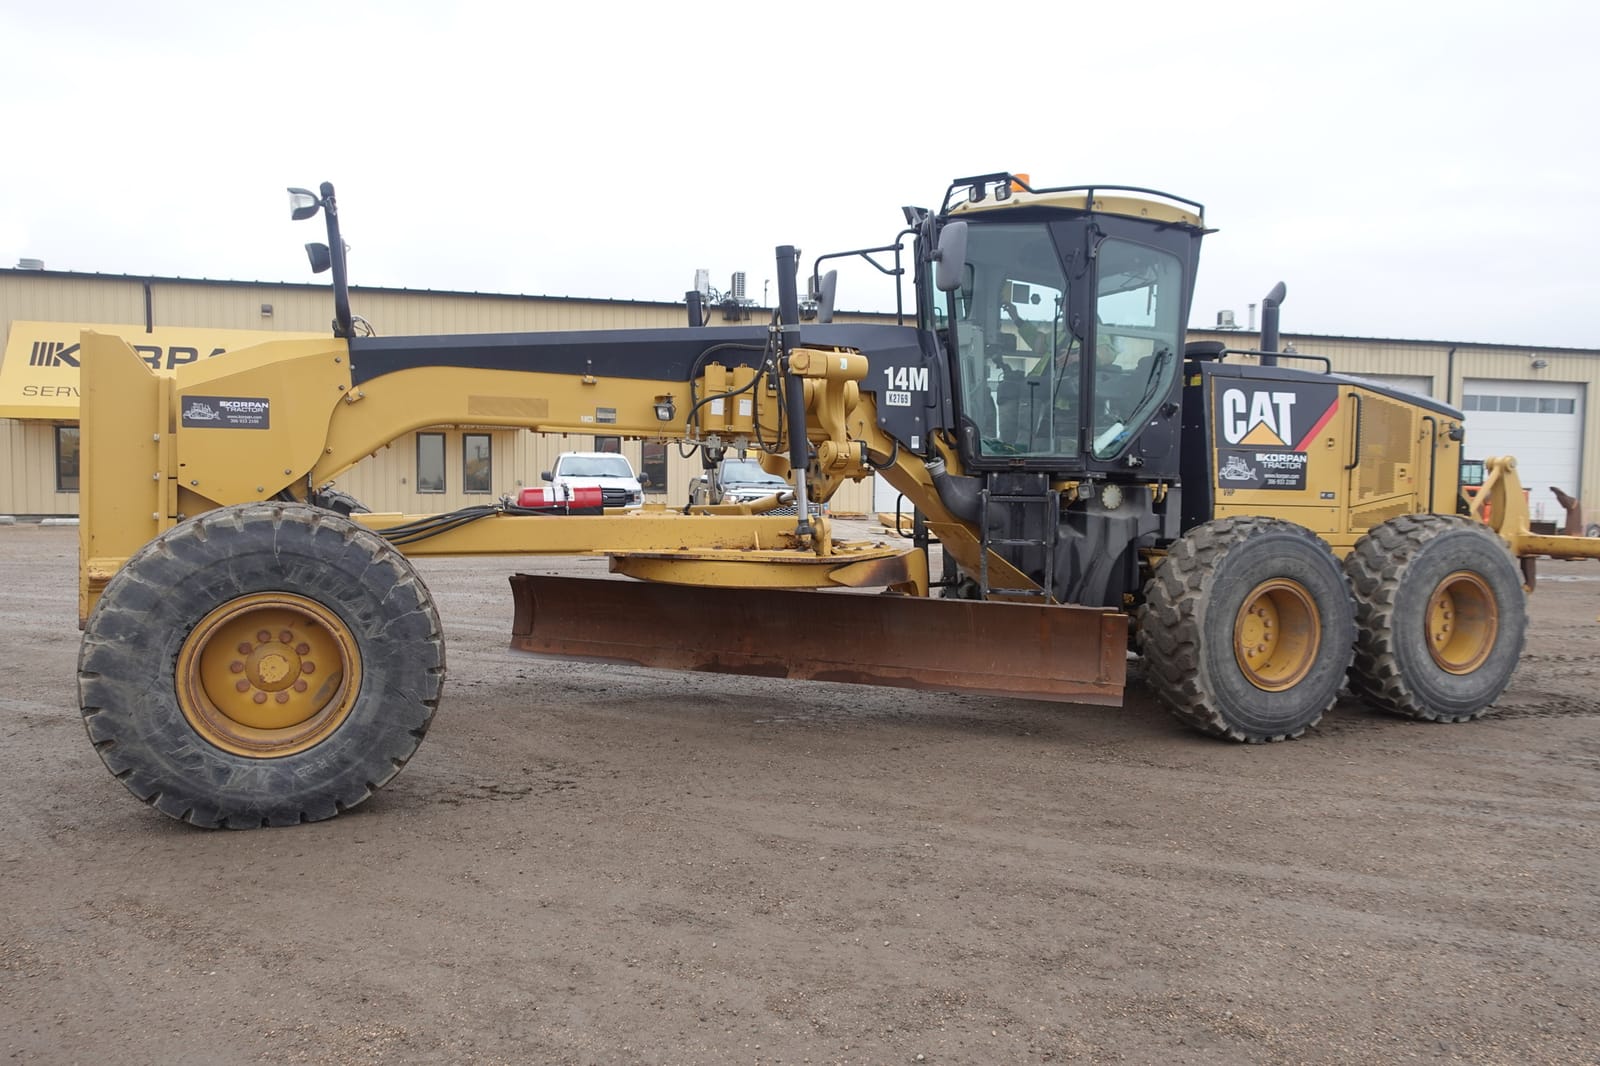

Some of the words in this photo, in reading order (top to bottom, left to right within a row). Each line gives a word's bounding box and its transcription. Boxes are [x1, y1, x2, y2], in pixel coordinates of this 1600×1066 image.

[884, 366, 929, 391] 14M
[1223, 388, 1297, 446] CAT
[1255, 453, 1307, 463] KORPAN
[1261, 461, 1302, 470] TRACTOR
